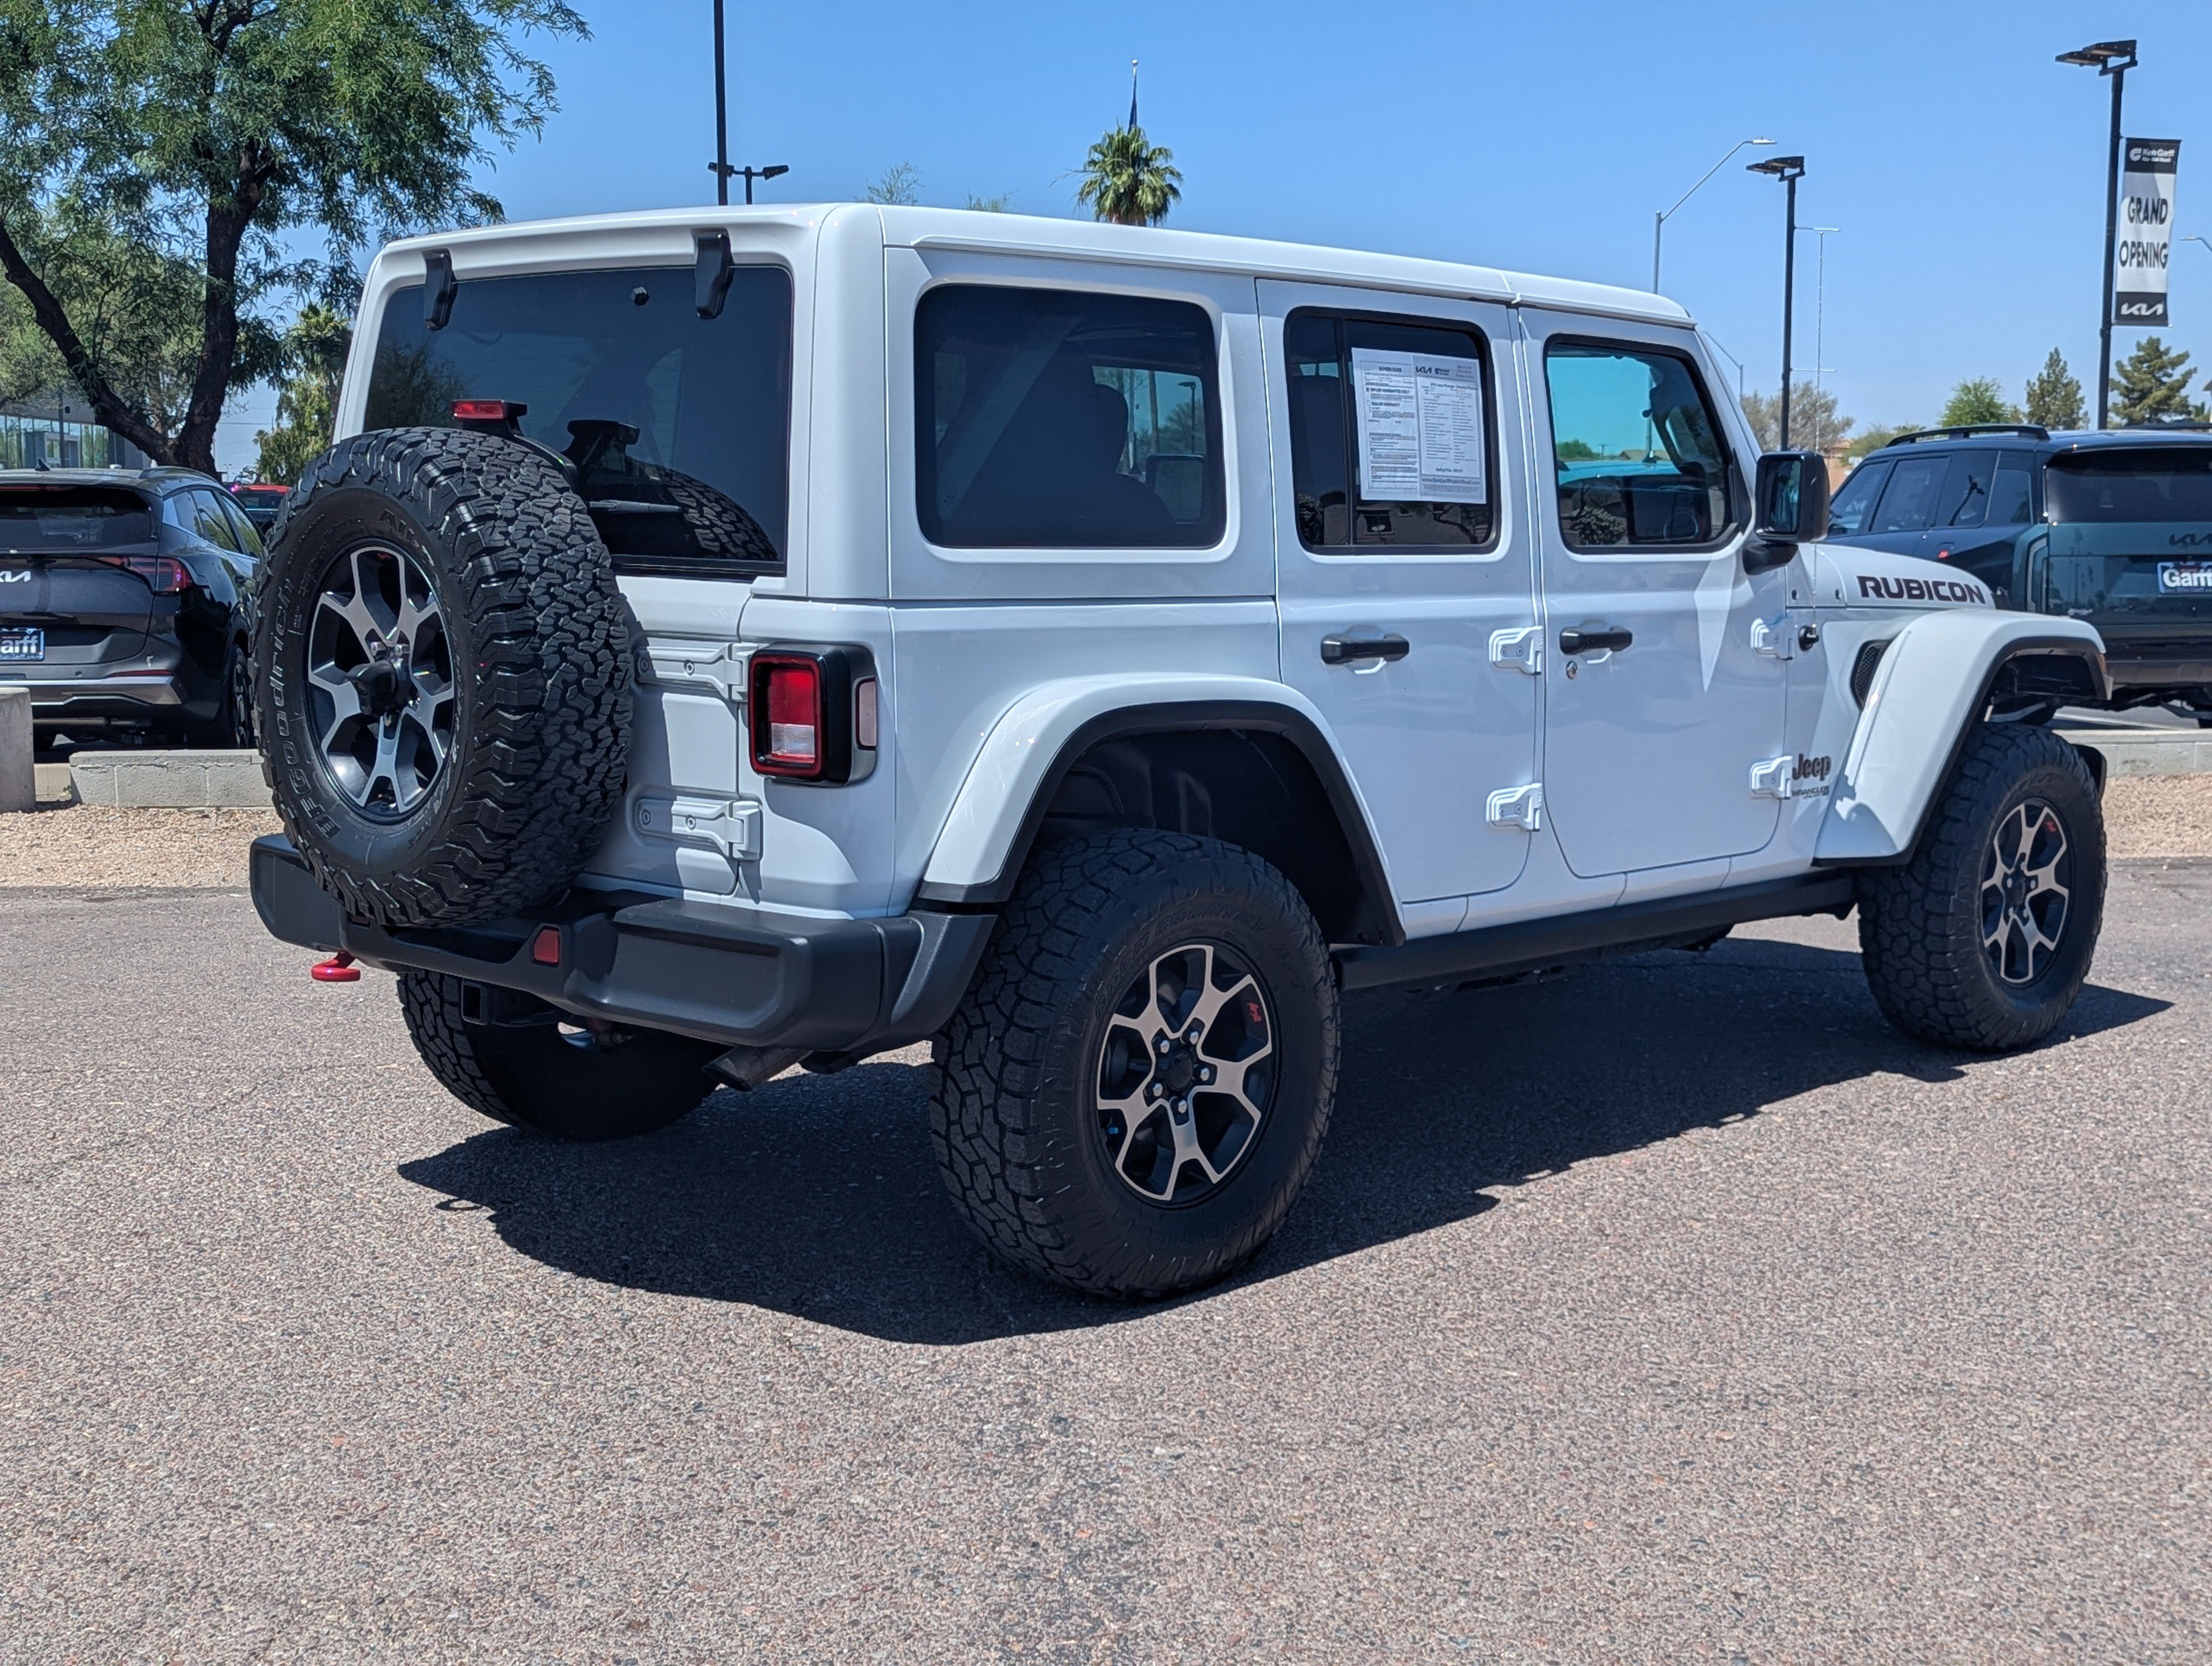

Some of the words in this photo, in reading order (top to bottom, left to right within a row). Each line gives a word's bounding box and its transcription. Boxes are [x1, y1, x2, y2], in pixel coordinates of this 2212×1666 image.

[2127, 196, 2169, 225] GRAND
[2119, 240, 2169, 270] OPENING
[2120, 303, 2164, 316] KIA
[1856, 575, 1986, 605] RUBICON
[0, 635, 38, 654] arff
[1792, 753, 1831, 781] Jeep
[1791, 785, 1829, 797] WRANGLER
